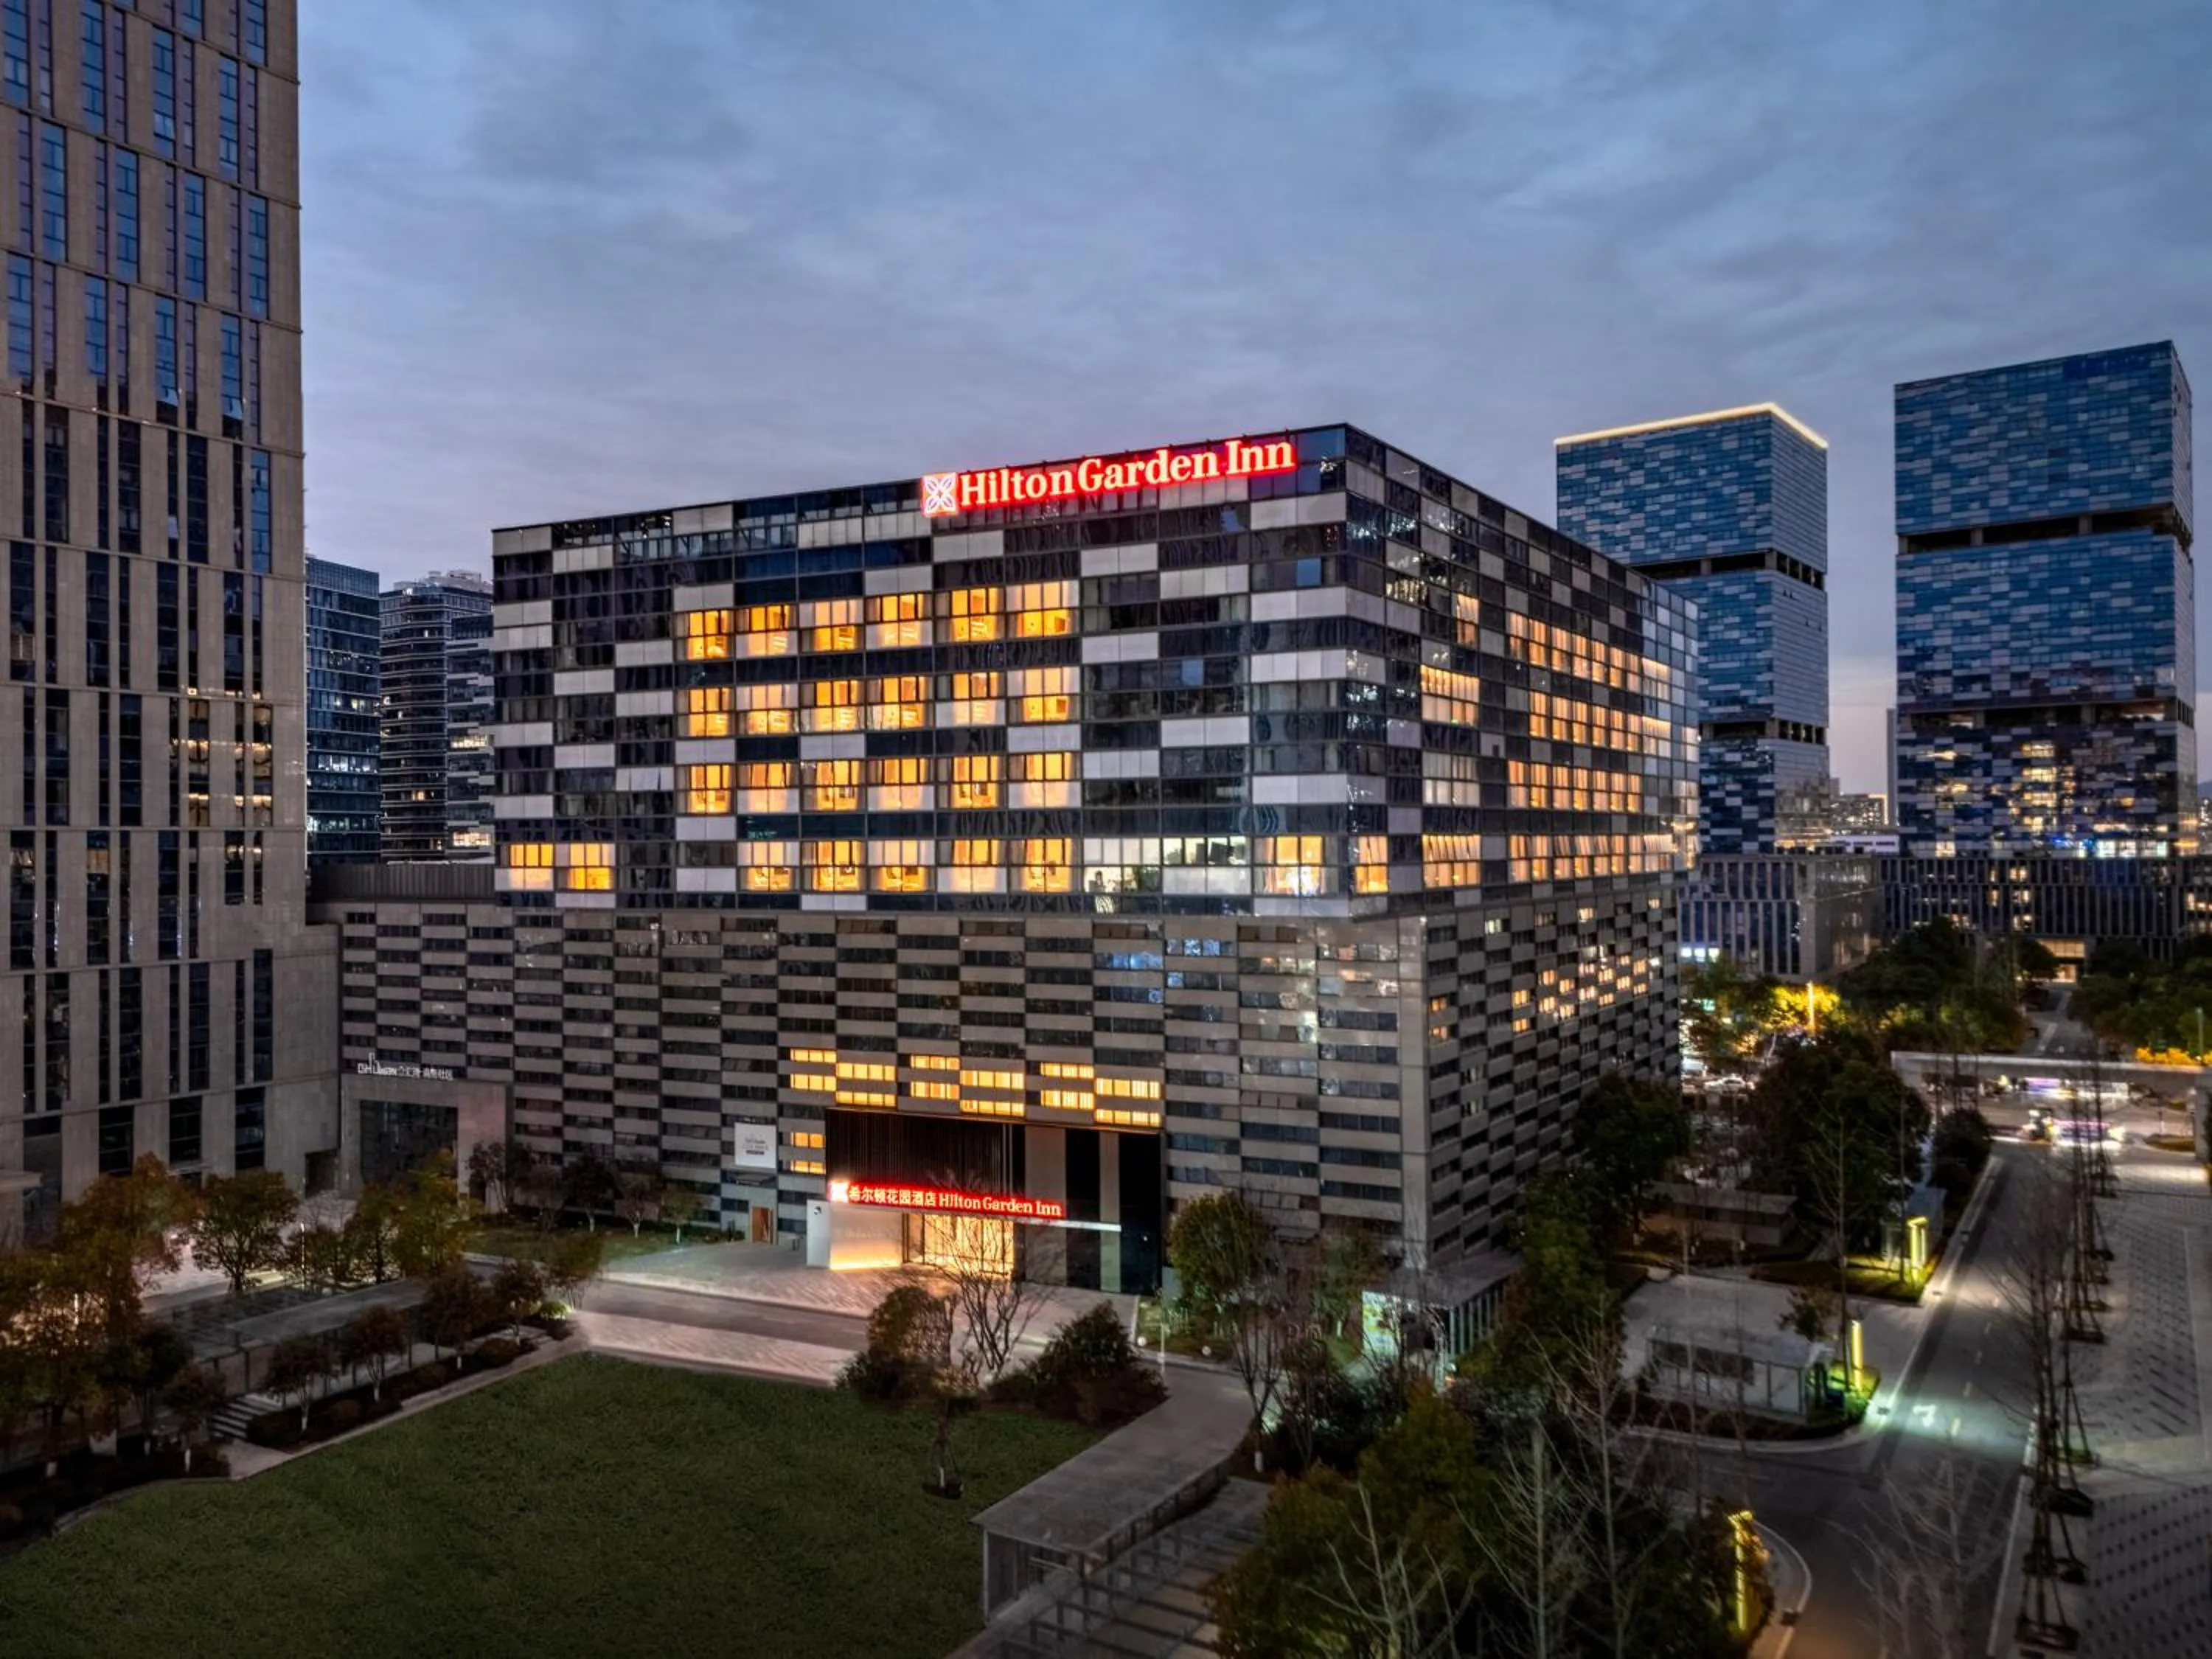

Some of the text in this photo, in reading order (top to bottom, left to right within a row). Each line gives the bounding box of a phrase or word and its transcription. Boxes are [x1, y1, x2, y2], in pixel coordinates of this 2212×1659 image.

[959, 441, 1295, 507] Hilton Garden Inn
[849, 1184, 1062, 1217] 希尔顿花园酒店 Hilton Garden Inn
